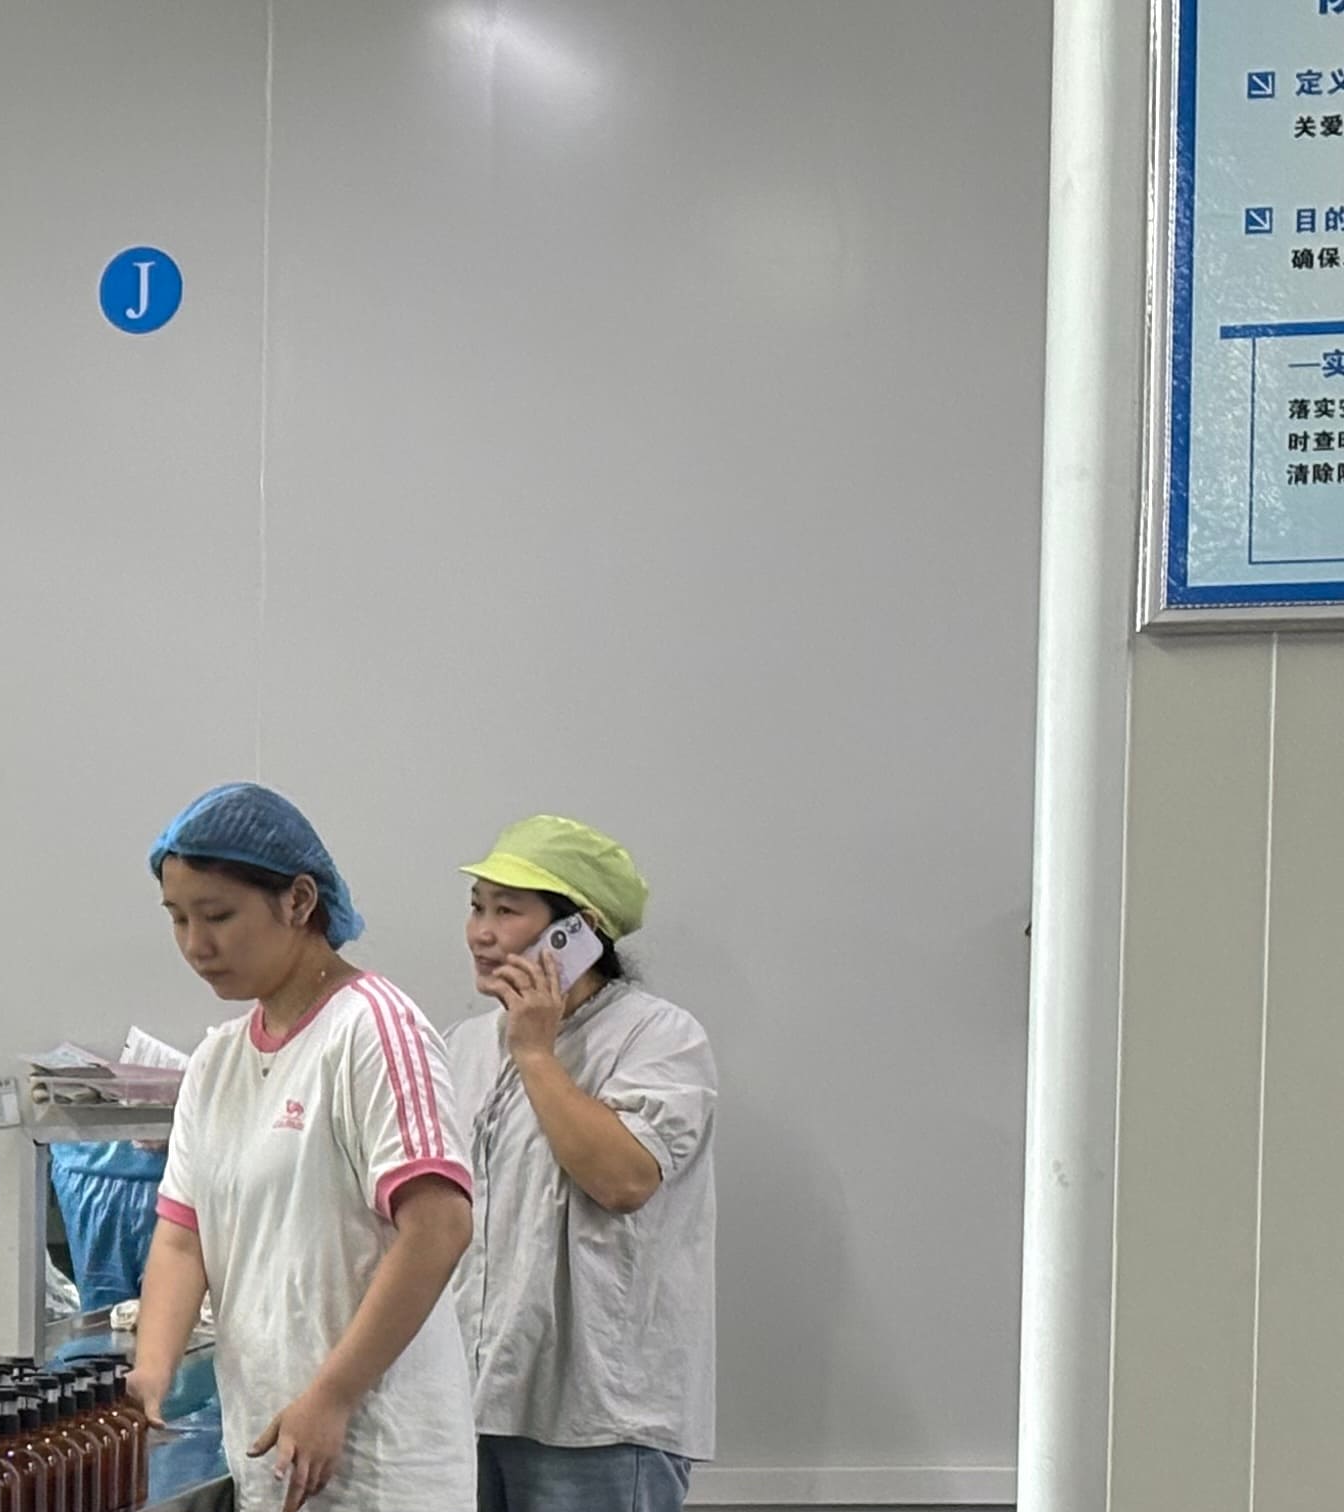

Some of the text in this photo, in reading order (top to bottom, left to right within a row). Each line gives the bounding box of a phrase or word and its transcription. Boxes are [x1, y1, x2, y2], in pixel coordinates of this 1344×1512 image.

[1295, 69, 1344, 97] 定义
[1294, 113, 1344, 139] 关爱
[1295, 206, 1344, 234] 目的
[1291, 247, 1344, 270] 确保
[125, 260, 155, 320] J
[1288, 397, 1344, 420] 落实
[1287, 431, 1344, 452] 时查
